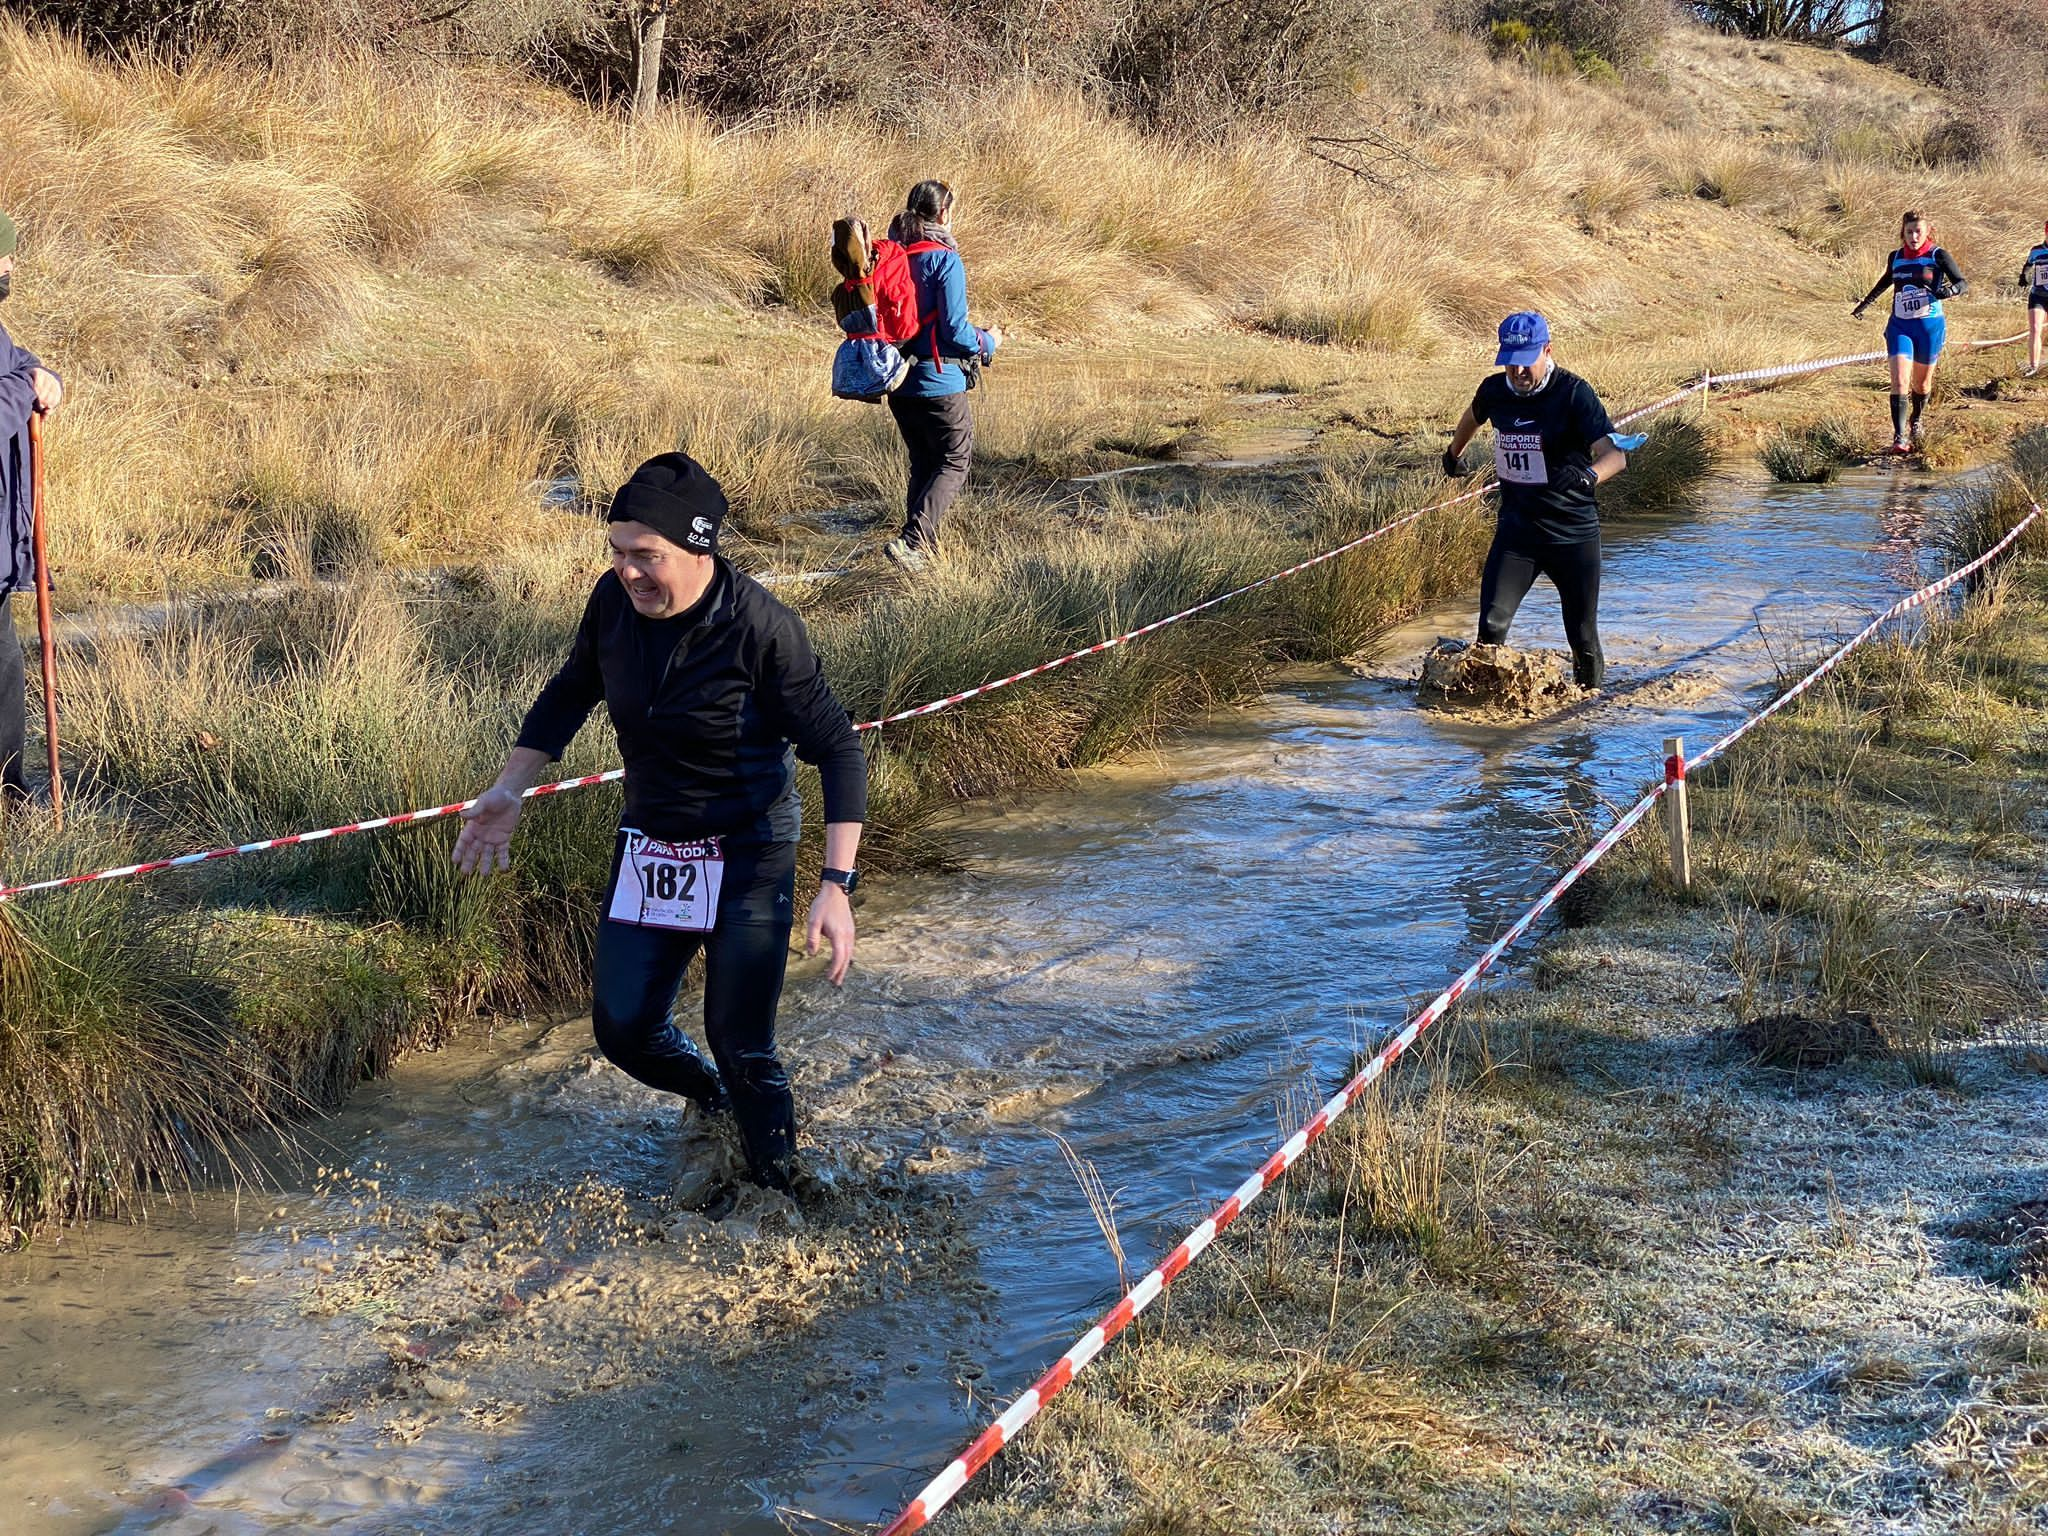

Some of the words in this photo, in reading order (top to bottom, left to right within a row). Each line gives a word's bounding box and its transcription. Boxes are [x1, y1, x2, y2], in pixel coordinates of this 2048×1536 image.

[1902, 299, 1921, 313] 140
[1500, 434, 1541, 443] DEPORTE
[1503, 452, 1530, 471] 141
[641, 861, 697, 902] 182
